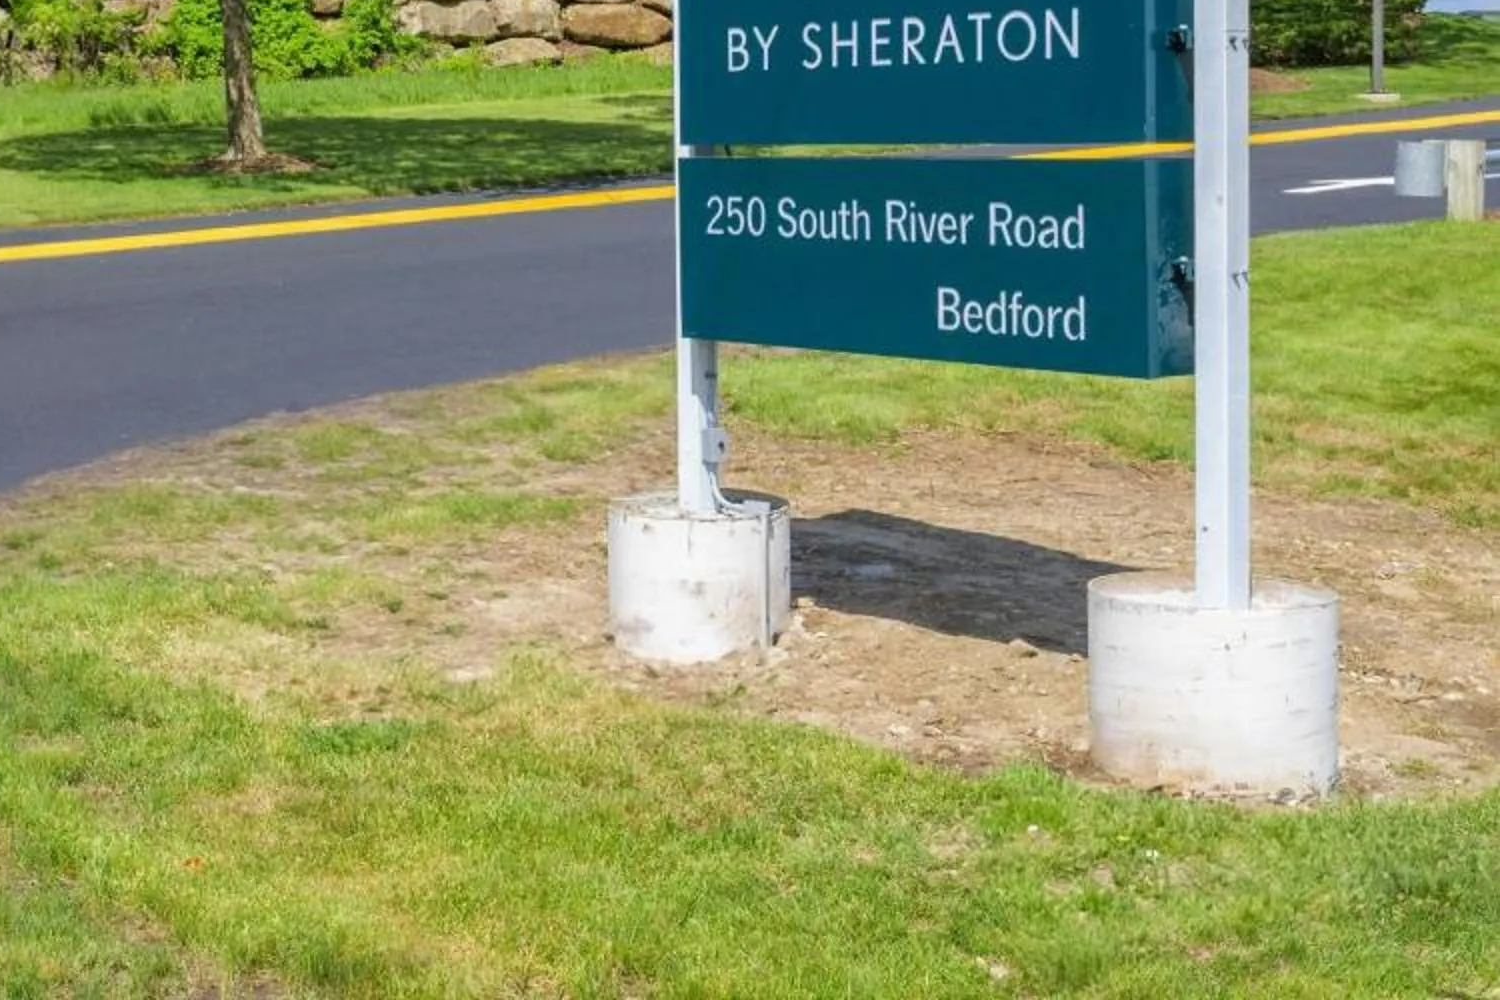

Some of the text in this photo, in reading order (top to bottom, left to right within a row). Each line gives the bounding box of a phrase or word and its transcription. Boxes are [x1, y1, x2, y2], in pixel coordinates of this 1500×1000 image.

[726, 8, 1080, 72] BY SHERATON
[706, 196, 1085, 249] 250 South River Road
[937, 287, 1086, 341] Bedford
